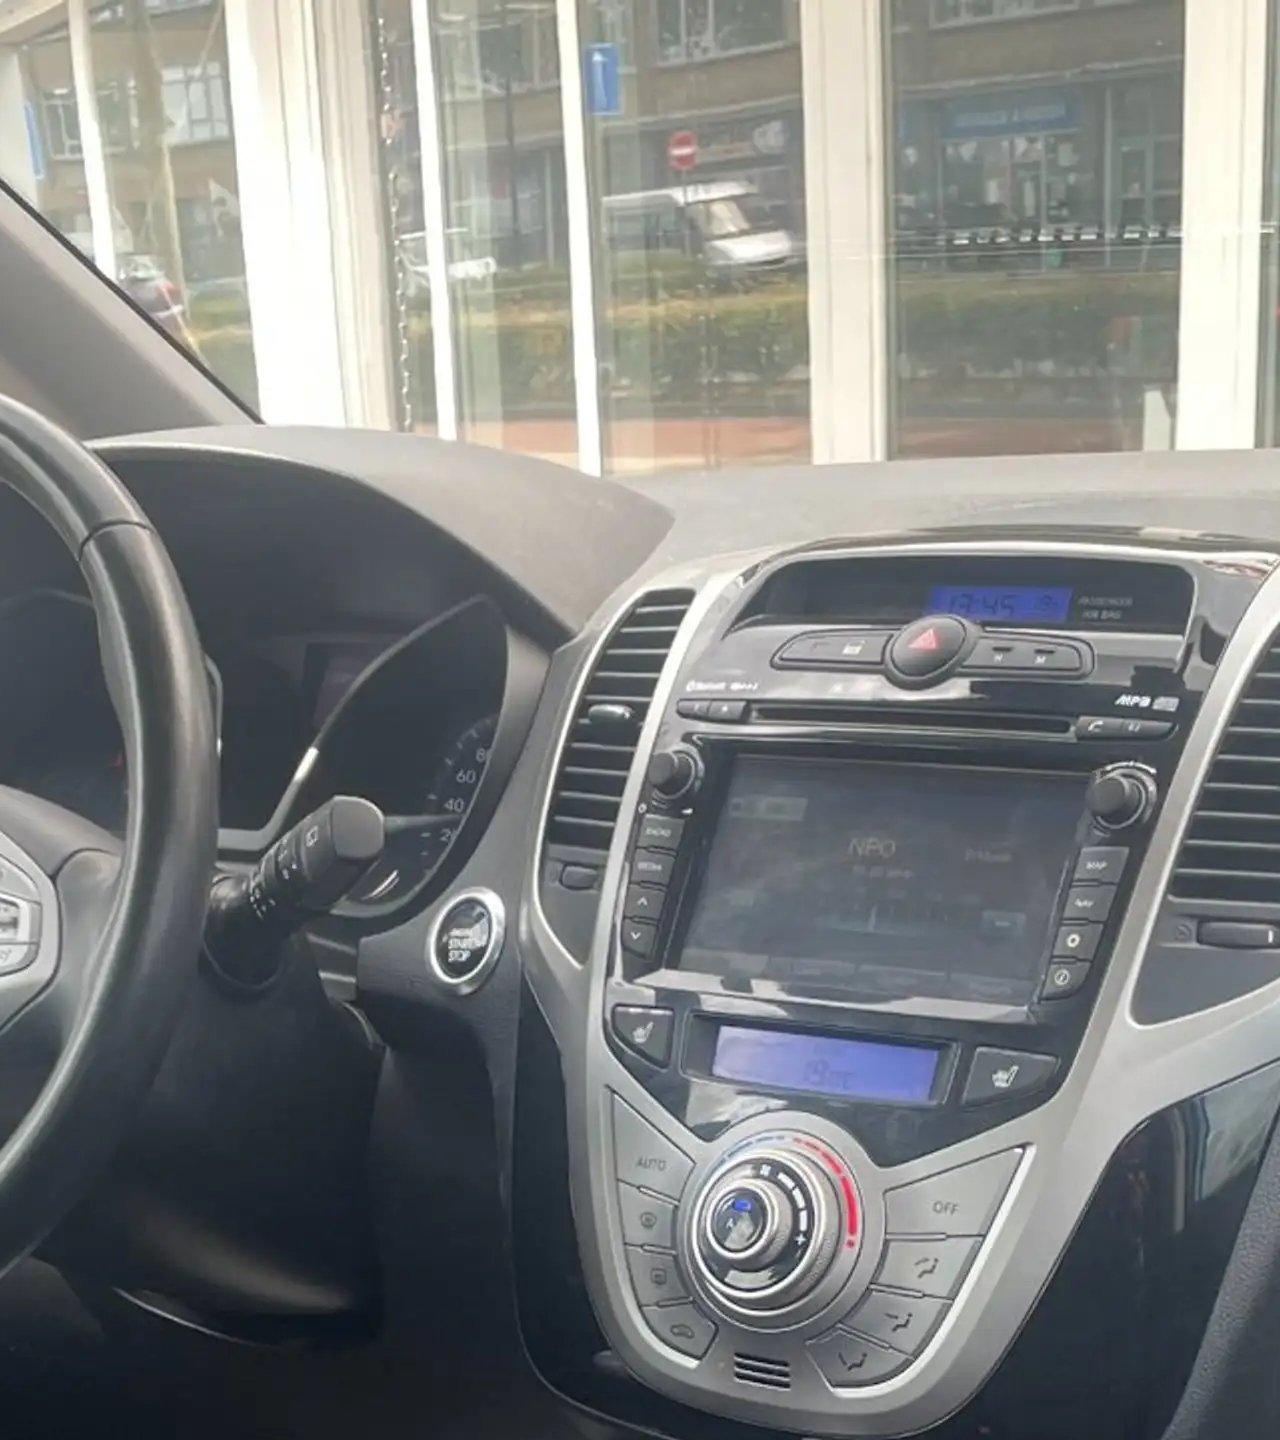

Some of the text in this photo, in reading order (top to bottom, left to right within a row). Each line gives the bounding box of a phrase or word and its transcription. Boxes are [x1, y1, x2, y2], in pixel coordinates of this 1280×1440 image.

[455, 769, 476, 784] 60
[443, 797, 465, 812] 40
[1086, 860, 1107, 870] MAP
[448, 950, 471, 962] STOP
[636, 1156, 667, 1173] AUTO
[931, 1200, 961, 1216] OFF
